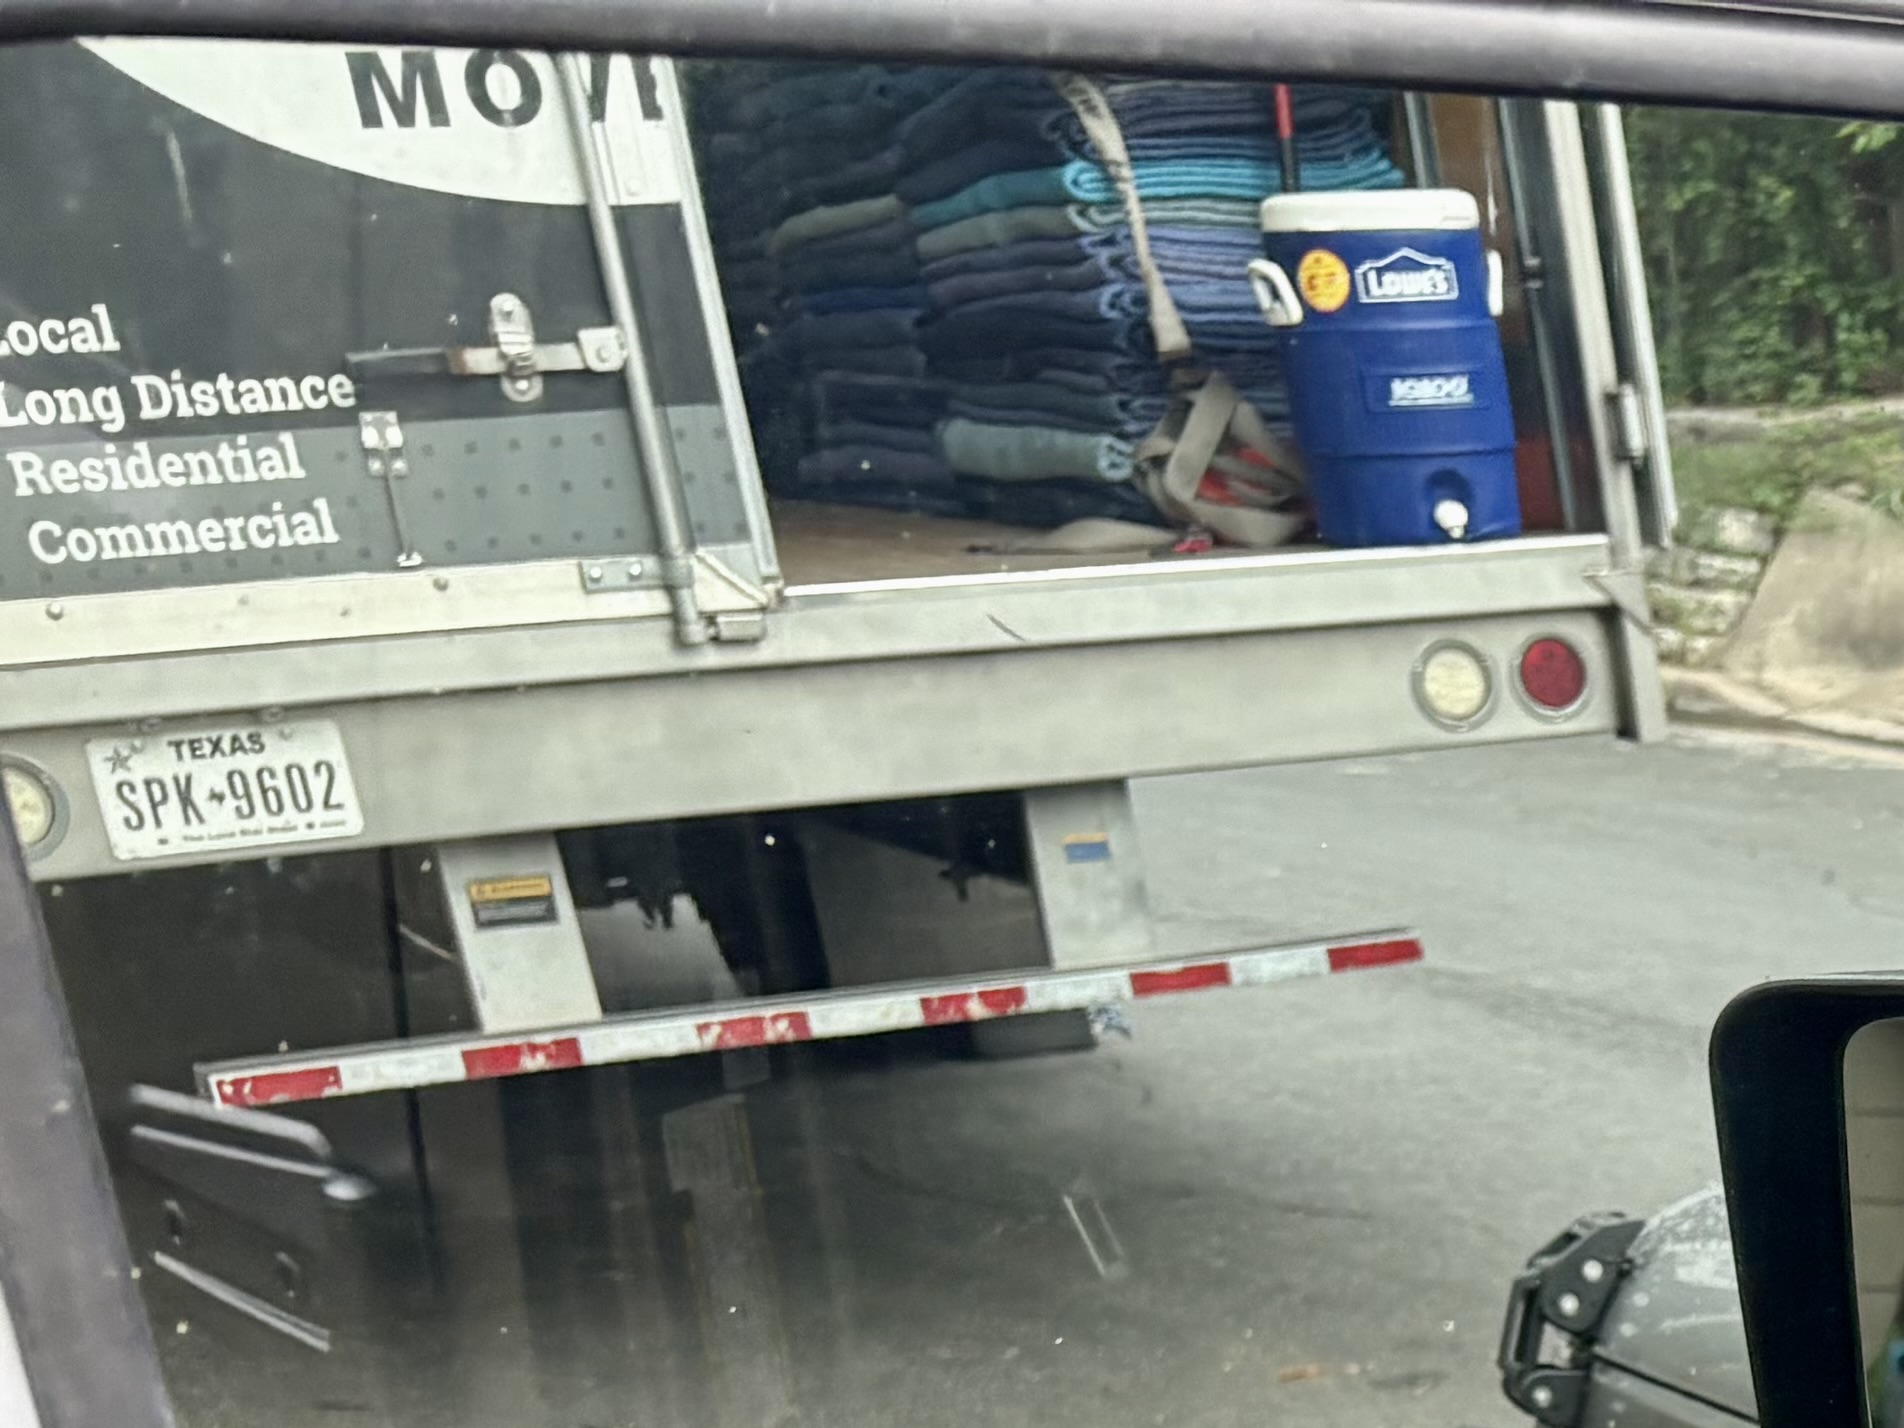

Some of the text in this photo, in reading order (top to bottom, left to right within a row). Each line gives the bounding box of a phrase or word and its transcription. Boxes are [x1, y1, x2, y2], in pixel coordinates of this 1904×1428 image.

[131, 368, 357, 420] Distance
[6, 431, 307, 497] Residential
[28, 496, 341, 565] Commercial
[167, 731, 266, 763] TEXAS
